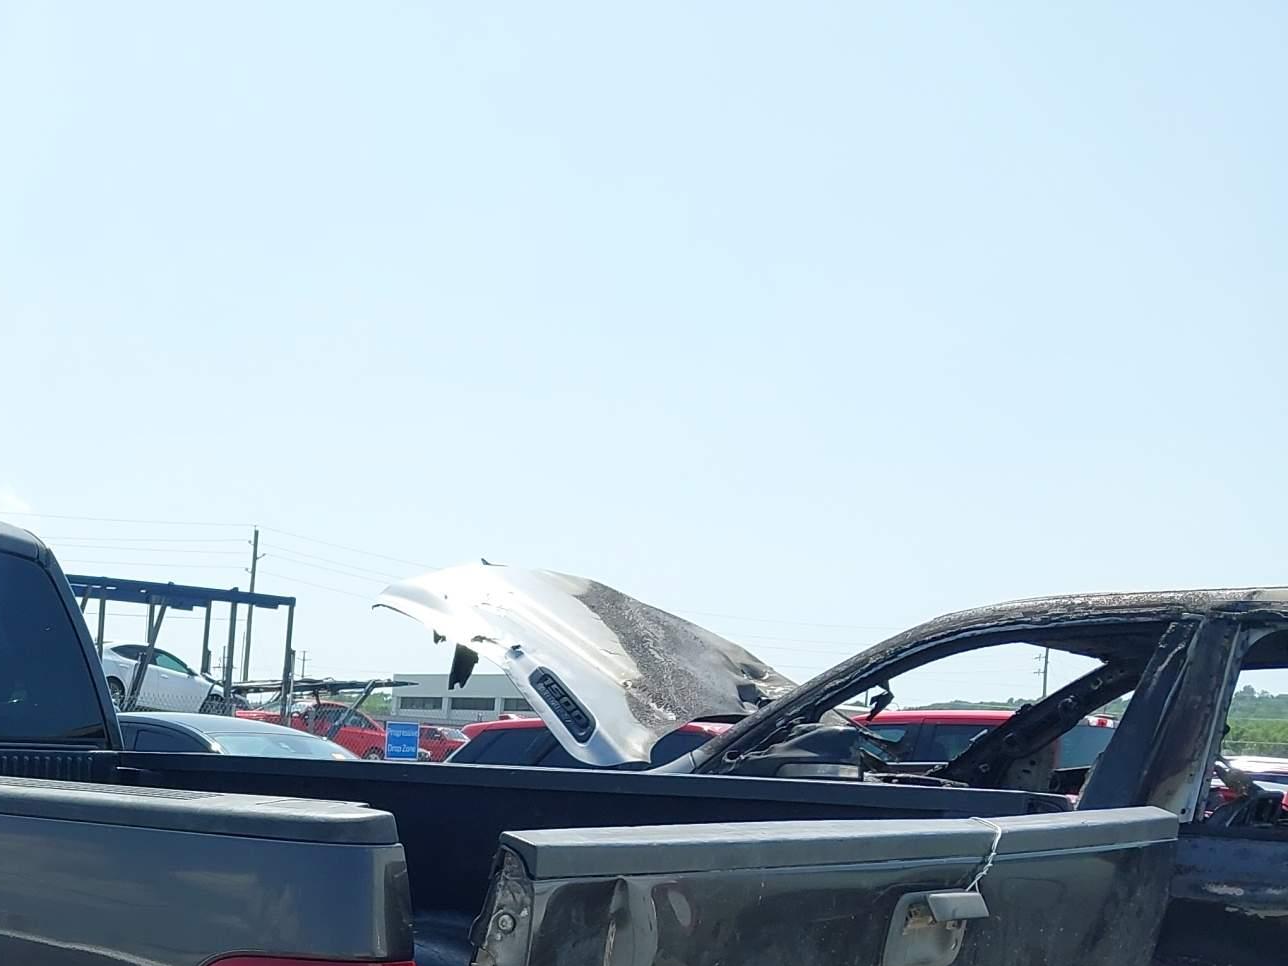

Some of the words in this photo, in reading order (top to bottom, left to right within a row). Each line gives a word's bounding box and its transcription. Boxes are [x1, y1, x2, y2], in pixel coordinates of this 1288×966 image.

[541, 676, 589, 726] 1500
[387, 727, 418, 737] Progressive
[387, 743, 402, 753] Drop
[402, 743, 416, 753] Zone
